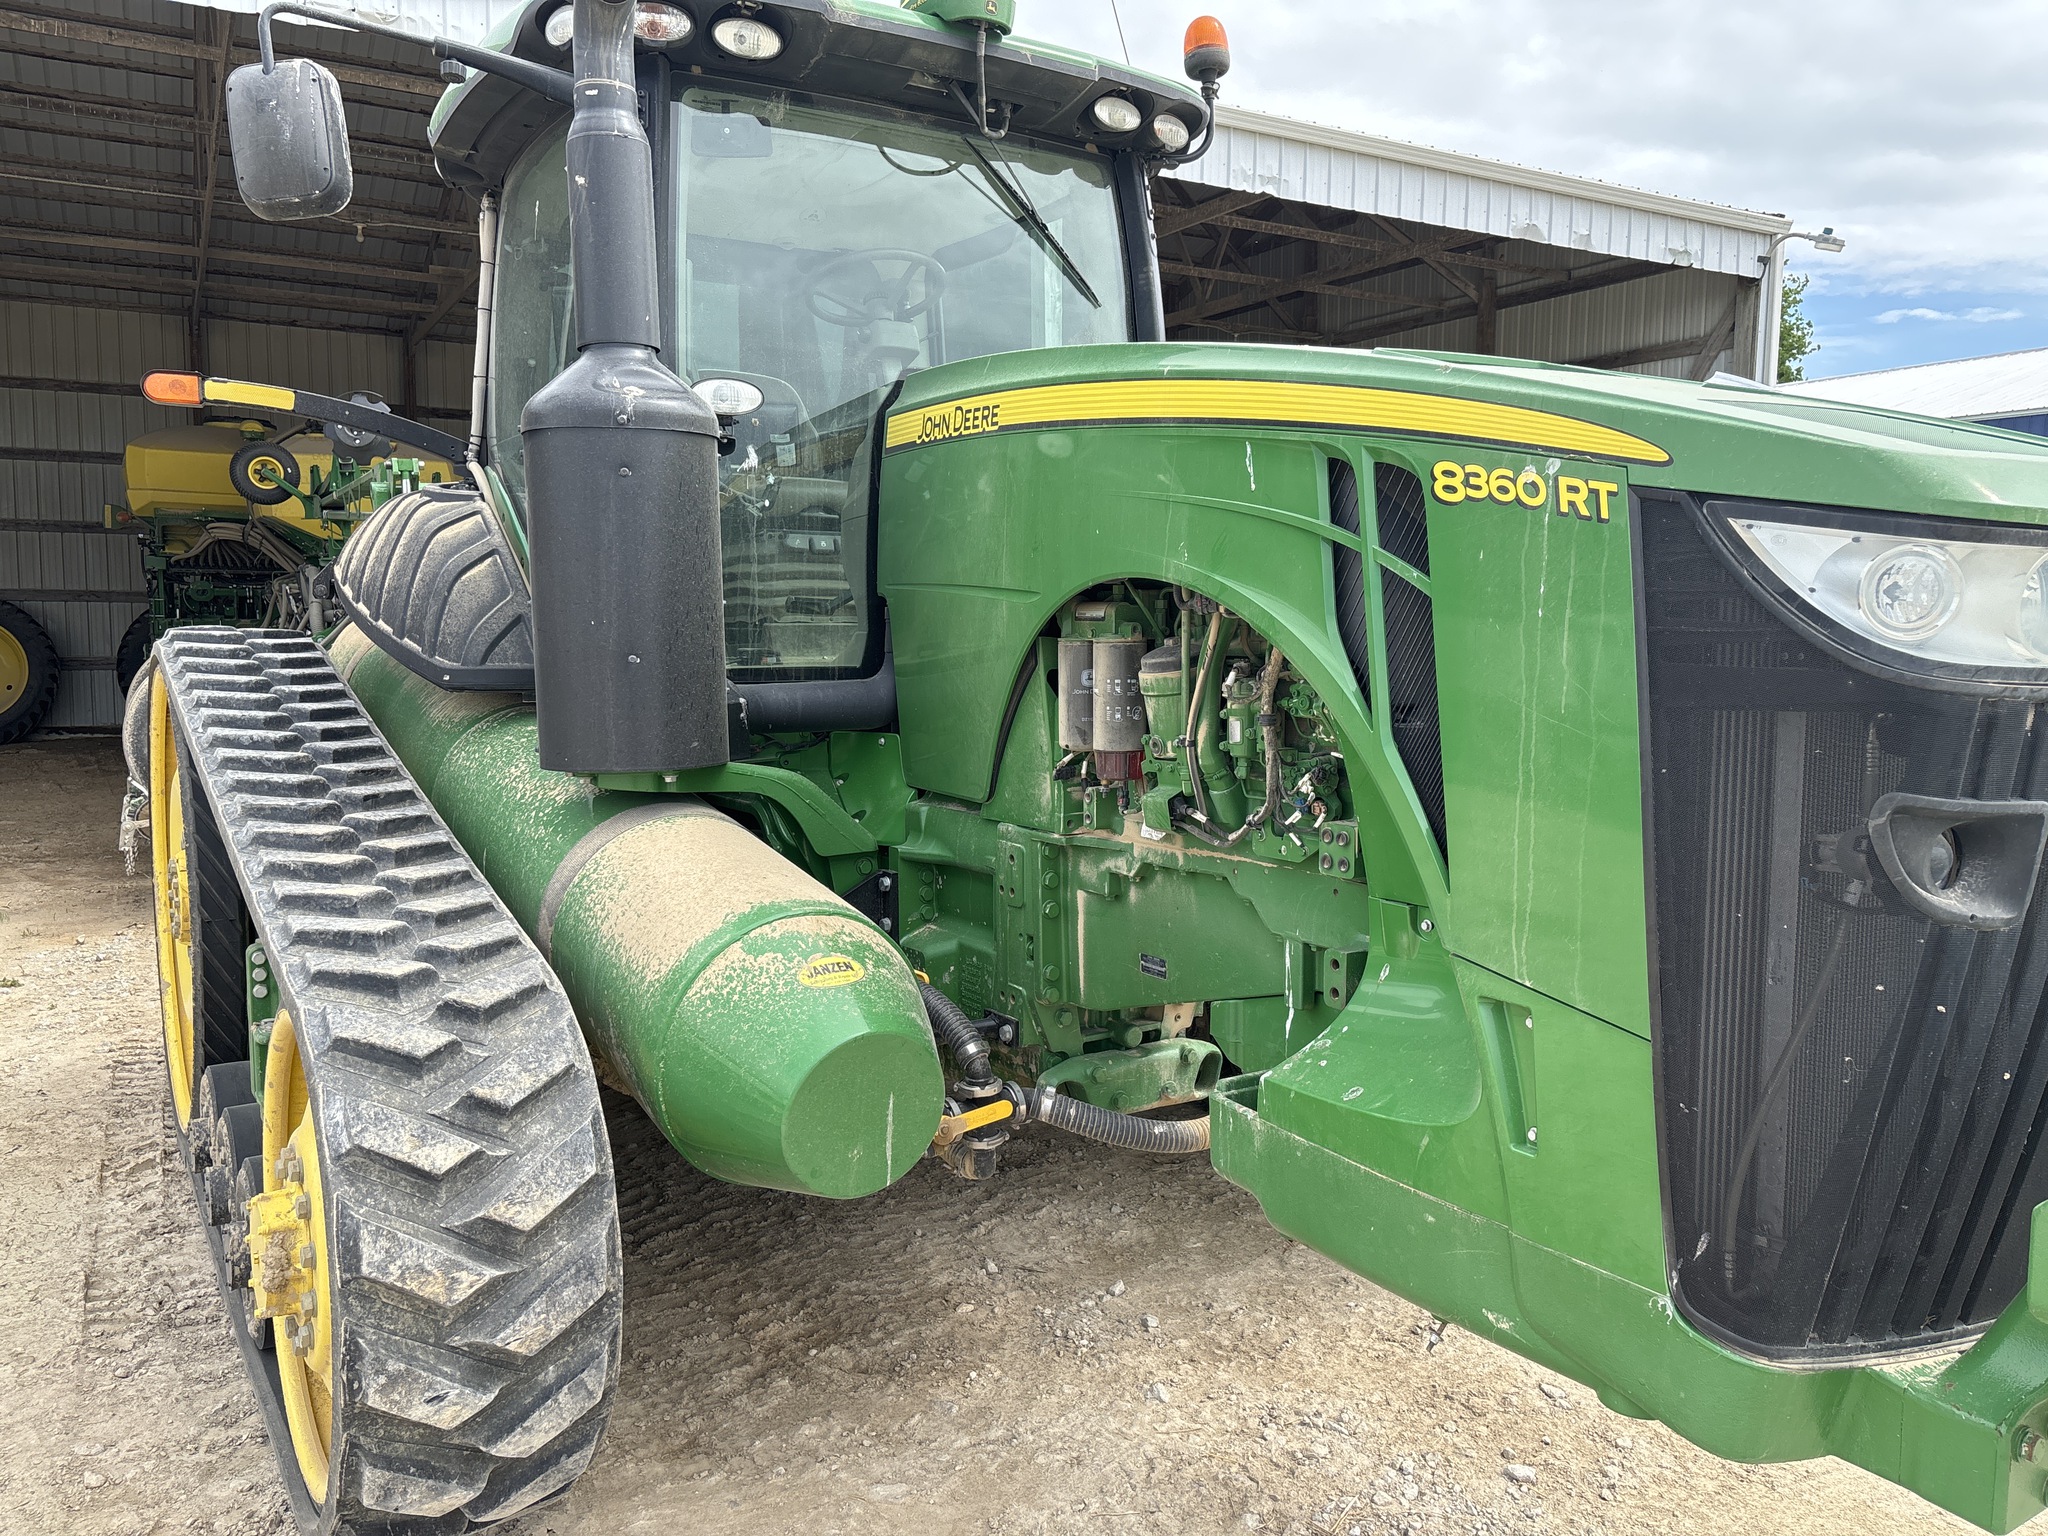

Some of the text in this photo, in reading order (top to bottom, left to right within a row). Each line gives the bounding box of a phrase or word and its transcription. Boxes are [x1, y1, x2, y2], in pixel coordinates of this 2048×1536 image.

[917, 404, 1001, 441] JOHN DEERE
[1431, 460, 1618, 522] 8360 RT
[807, 961, 855, 979] JANZEN
